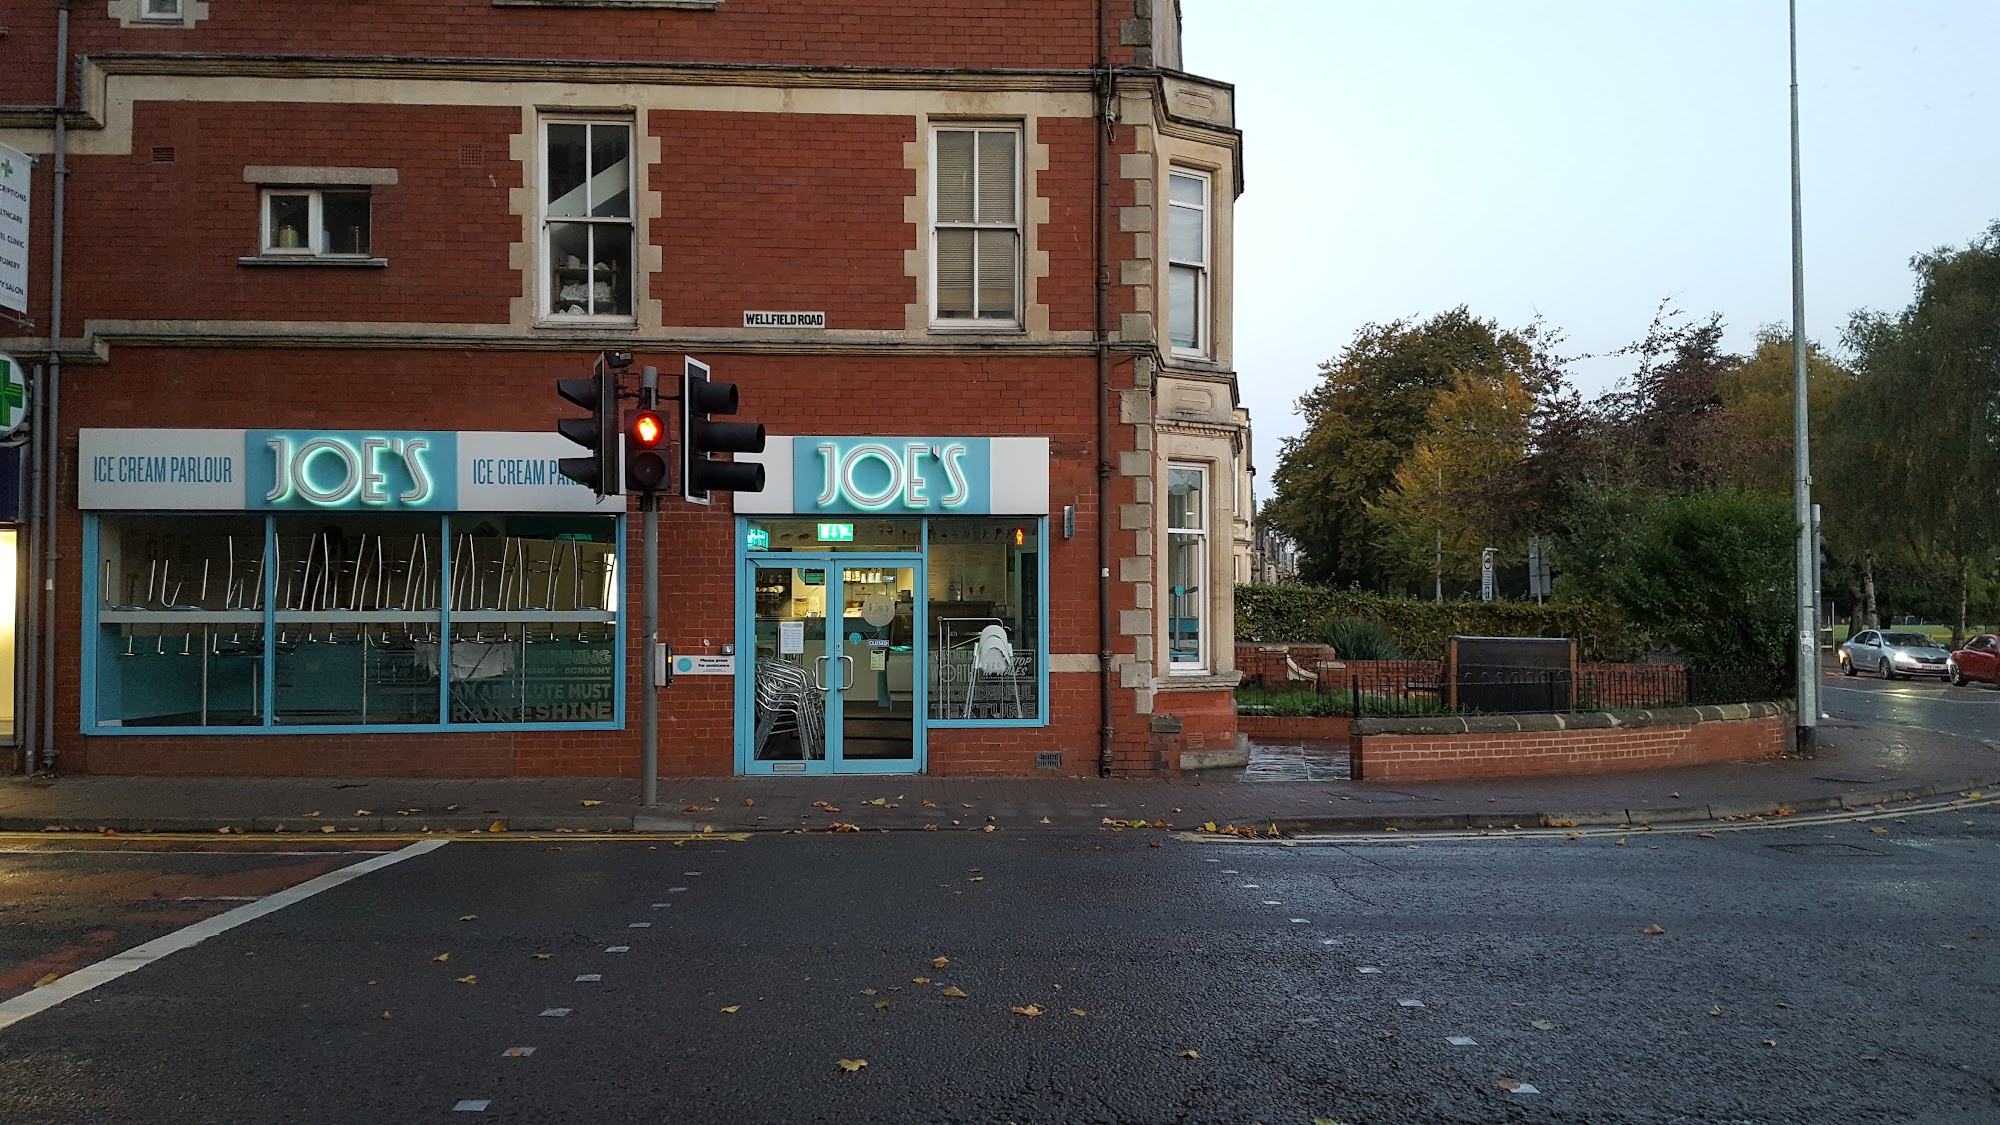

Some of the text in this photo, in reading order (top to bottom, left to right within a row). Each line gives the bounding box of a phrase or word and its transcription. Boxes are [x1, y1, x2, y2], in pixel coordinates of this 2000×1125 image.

[745, 313, 823, 325] WELLFIELD ROAD
[94, 456, 232, 483] ICE CREAM PARLOUR
[266, 438, 429, 502] JOE'S
[473, 459, 495, 485] ICE
[498, 459, 545, 485] CREAM
[818, 444, 967, 506] JOE'S
[564, 666, 611, 674] SCRUMMY
[568, 684, 611, 699] MUST
[535, 701, 612, 720] SHINE
[931, 703, 1036, 719] TEXTURE
